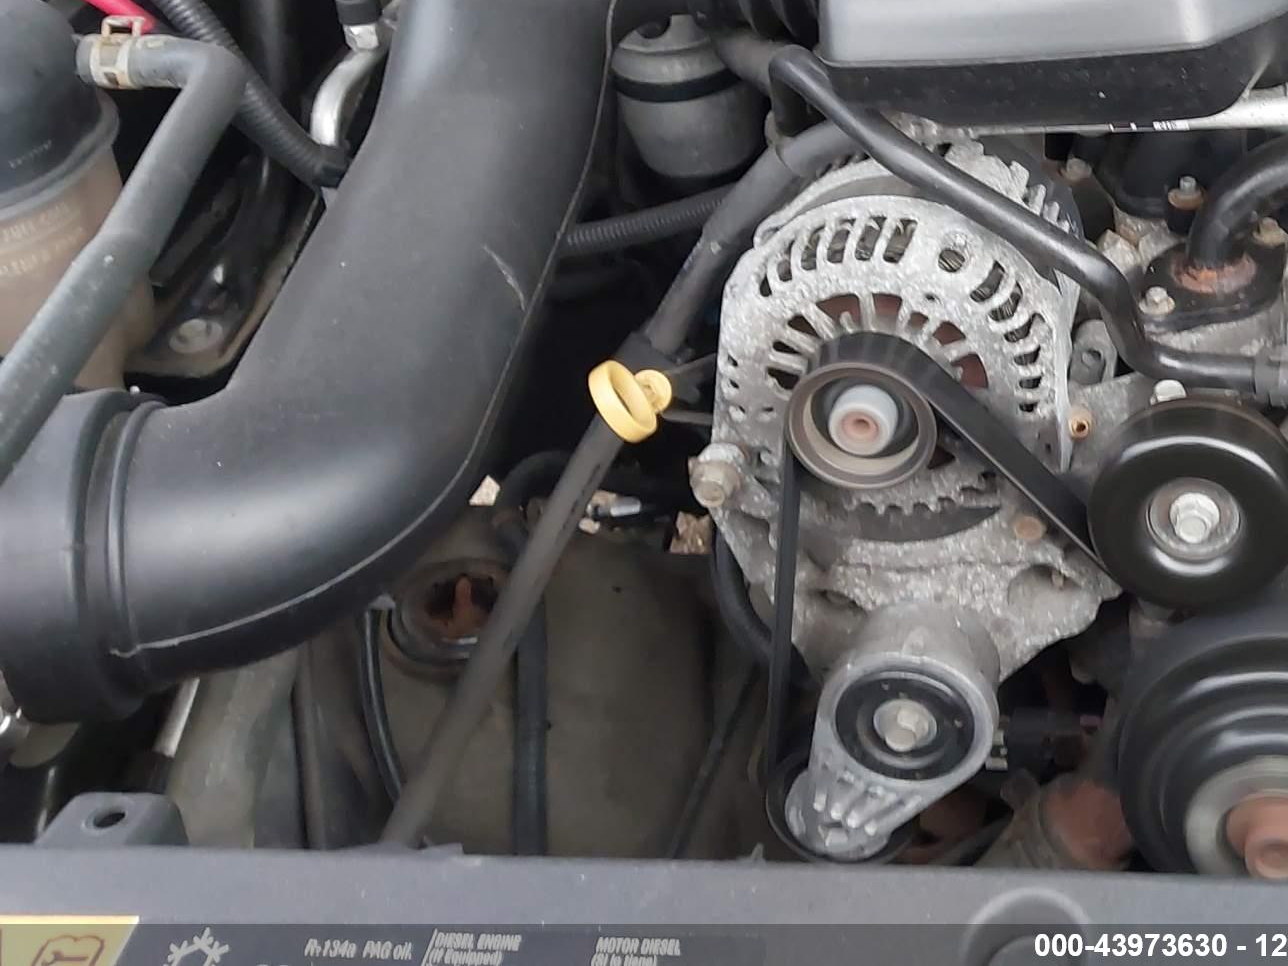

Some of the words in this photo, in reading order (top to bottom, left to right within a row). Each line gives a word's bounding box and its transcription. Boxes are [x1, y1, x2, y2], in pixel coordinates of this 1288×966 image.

[362, 940, 393, 959] PAG
[434, 932, 474, 949] DIESEL
[477, 933, 522, 951] ENGINE
[596, 937, 640, 954] MOTOR
[640, 938, 681, 956] DIESEL
